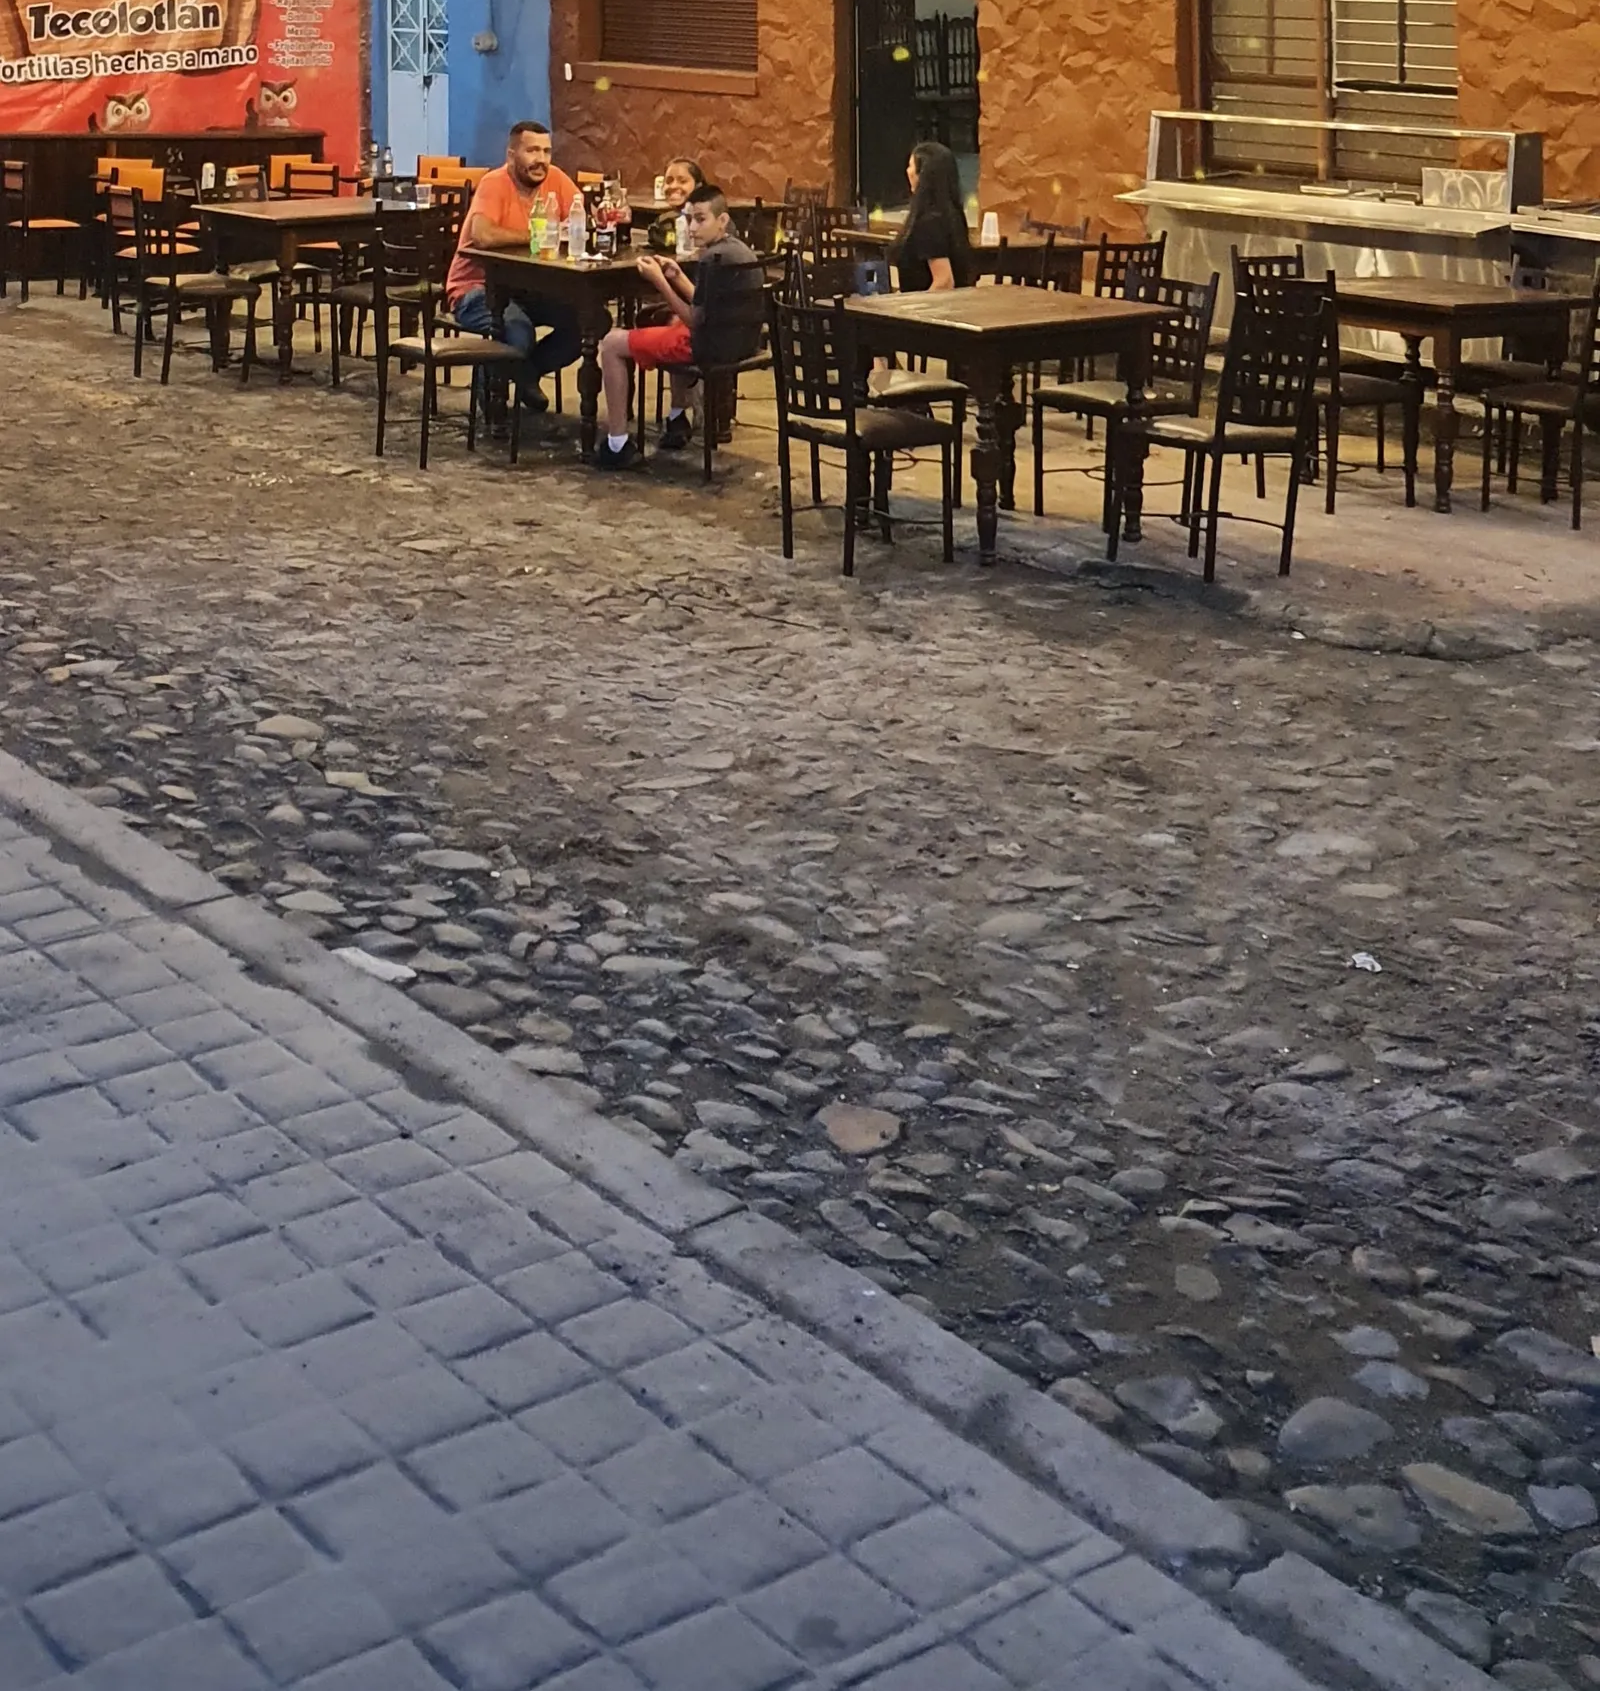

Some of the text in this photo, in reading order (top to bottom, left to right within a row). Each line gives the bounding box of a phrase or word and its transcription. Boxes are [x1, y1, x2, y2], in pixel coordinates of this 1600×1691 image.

[0, 47, 257, 79] ortillas hechas a mano
